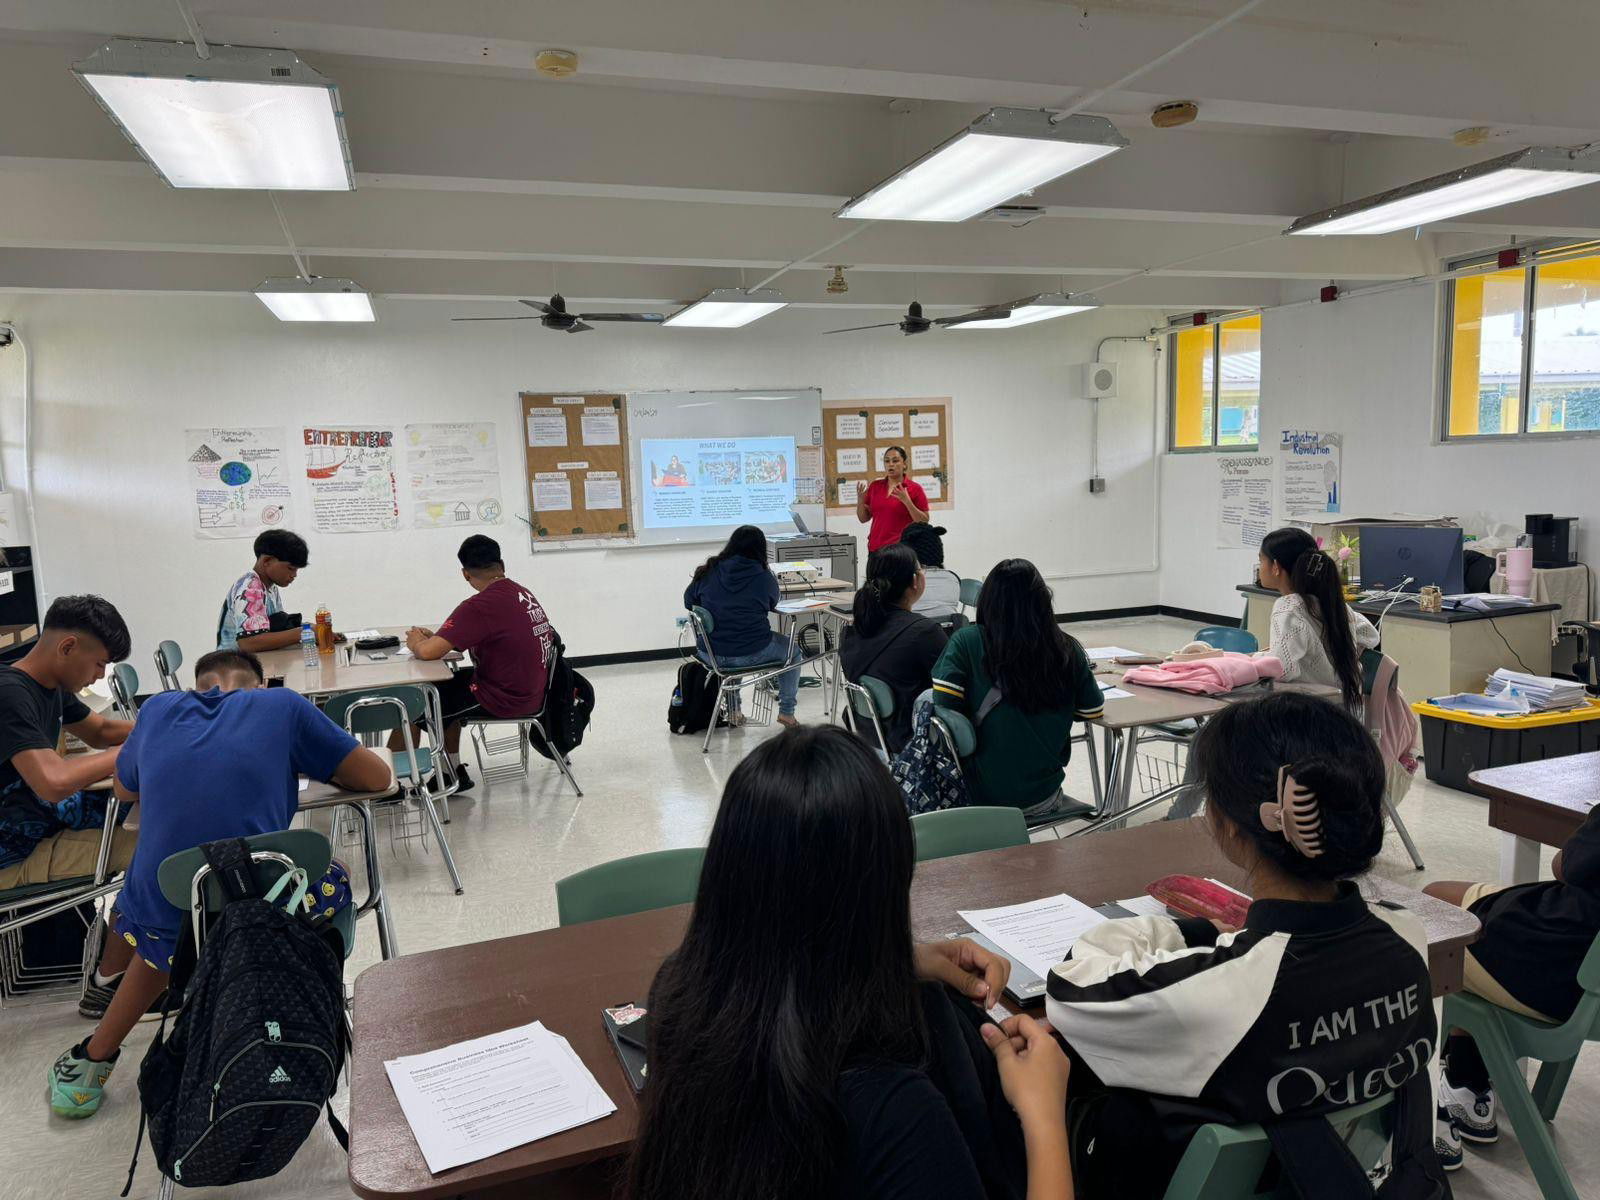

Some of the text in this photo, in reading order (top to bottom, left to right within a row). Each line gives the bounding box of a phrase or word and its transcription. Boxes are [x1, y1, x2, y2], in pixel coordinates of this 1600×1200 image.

[699, 441, 736, 450] WHAT WE DO
[1293, 442, 1330, 456] Revolution
[1288, 984, 1419, 1050] I AM THE
[1266, 1037, 1433, 1116] Queen
